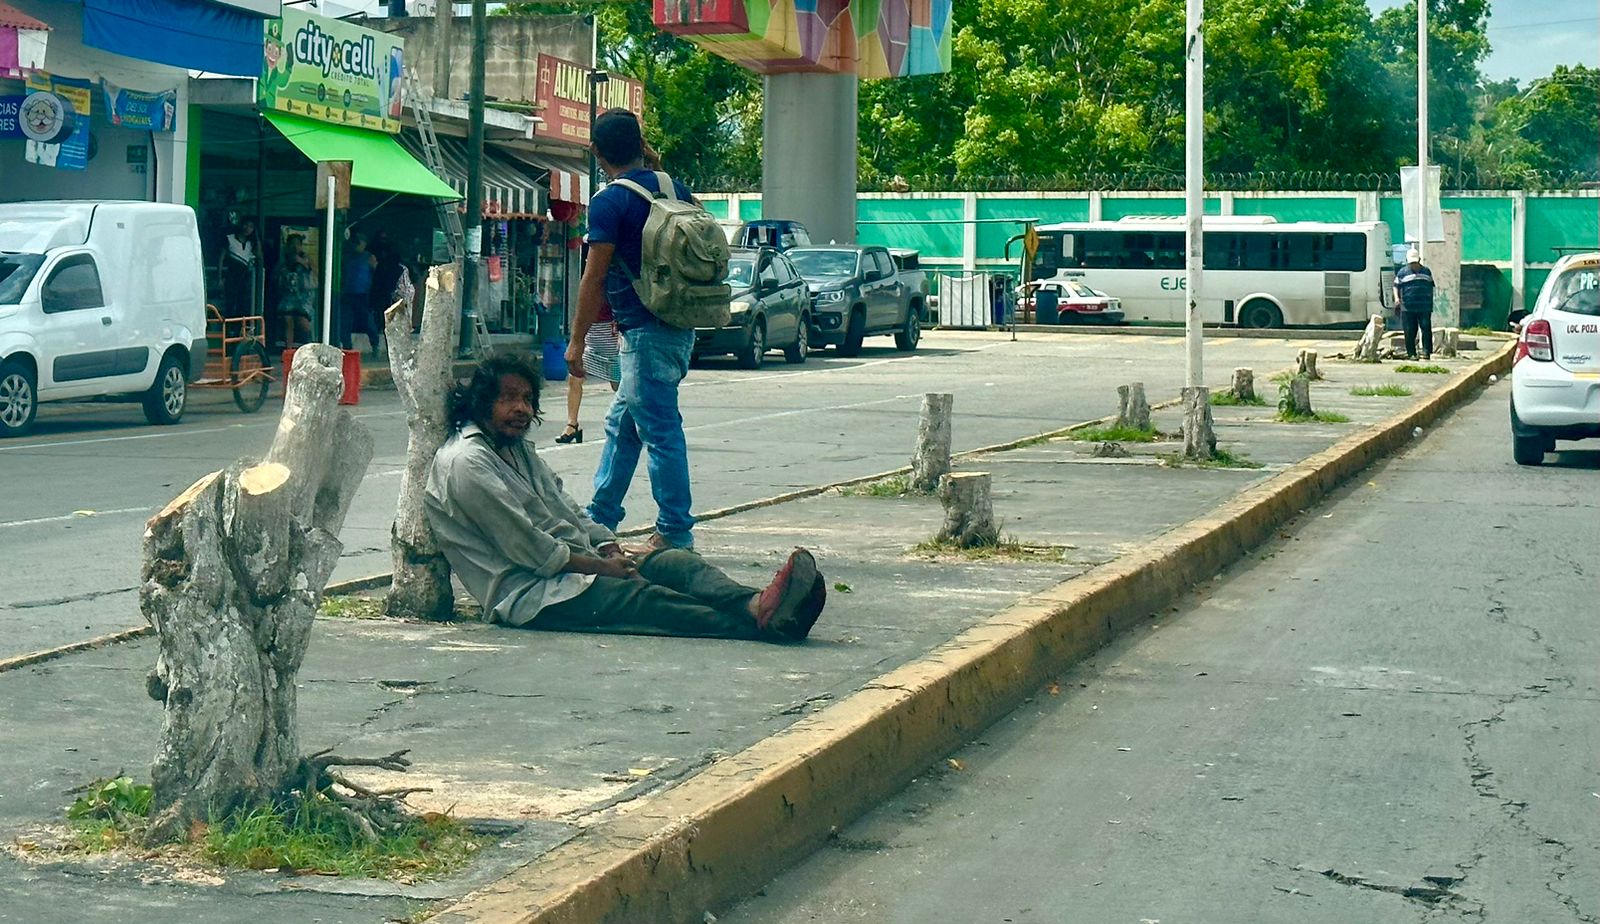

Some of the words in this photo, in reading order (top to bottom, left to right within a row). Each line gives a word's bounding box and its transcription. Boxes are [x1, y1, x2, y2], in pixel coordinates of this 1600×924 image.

[295, 20, 334, 78] city
[340, 34, 375, 79] cell
[1581, 324, 1598, 333] POZA
